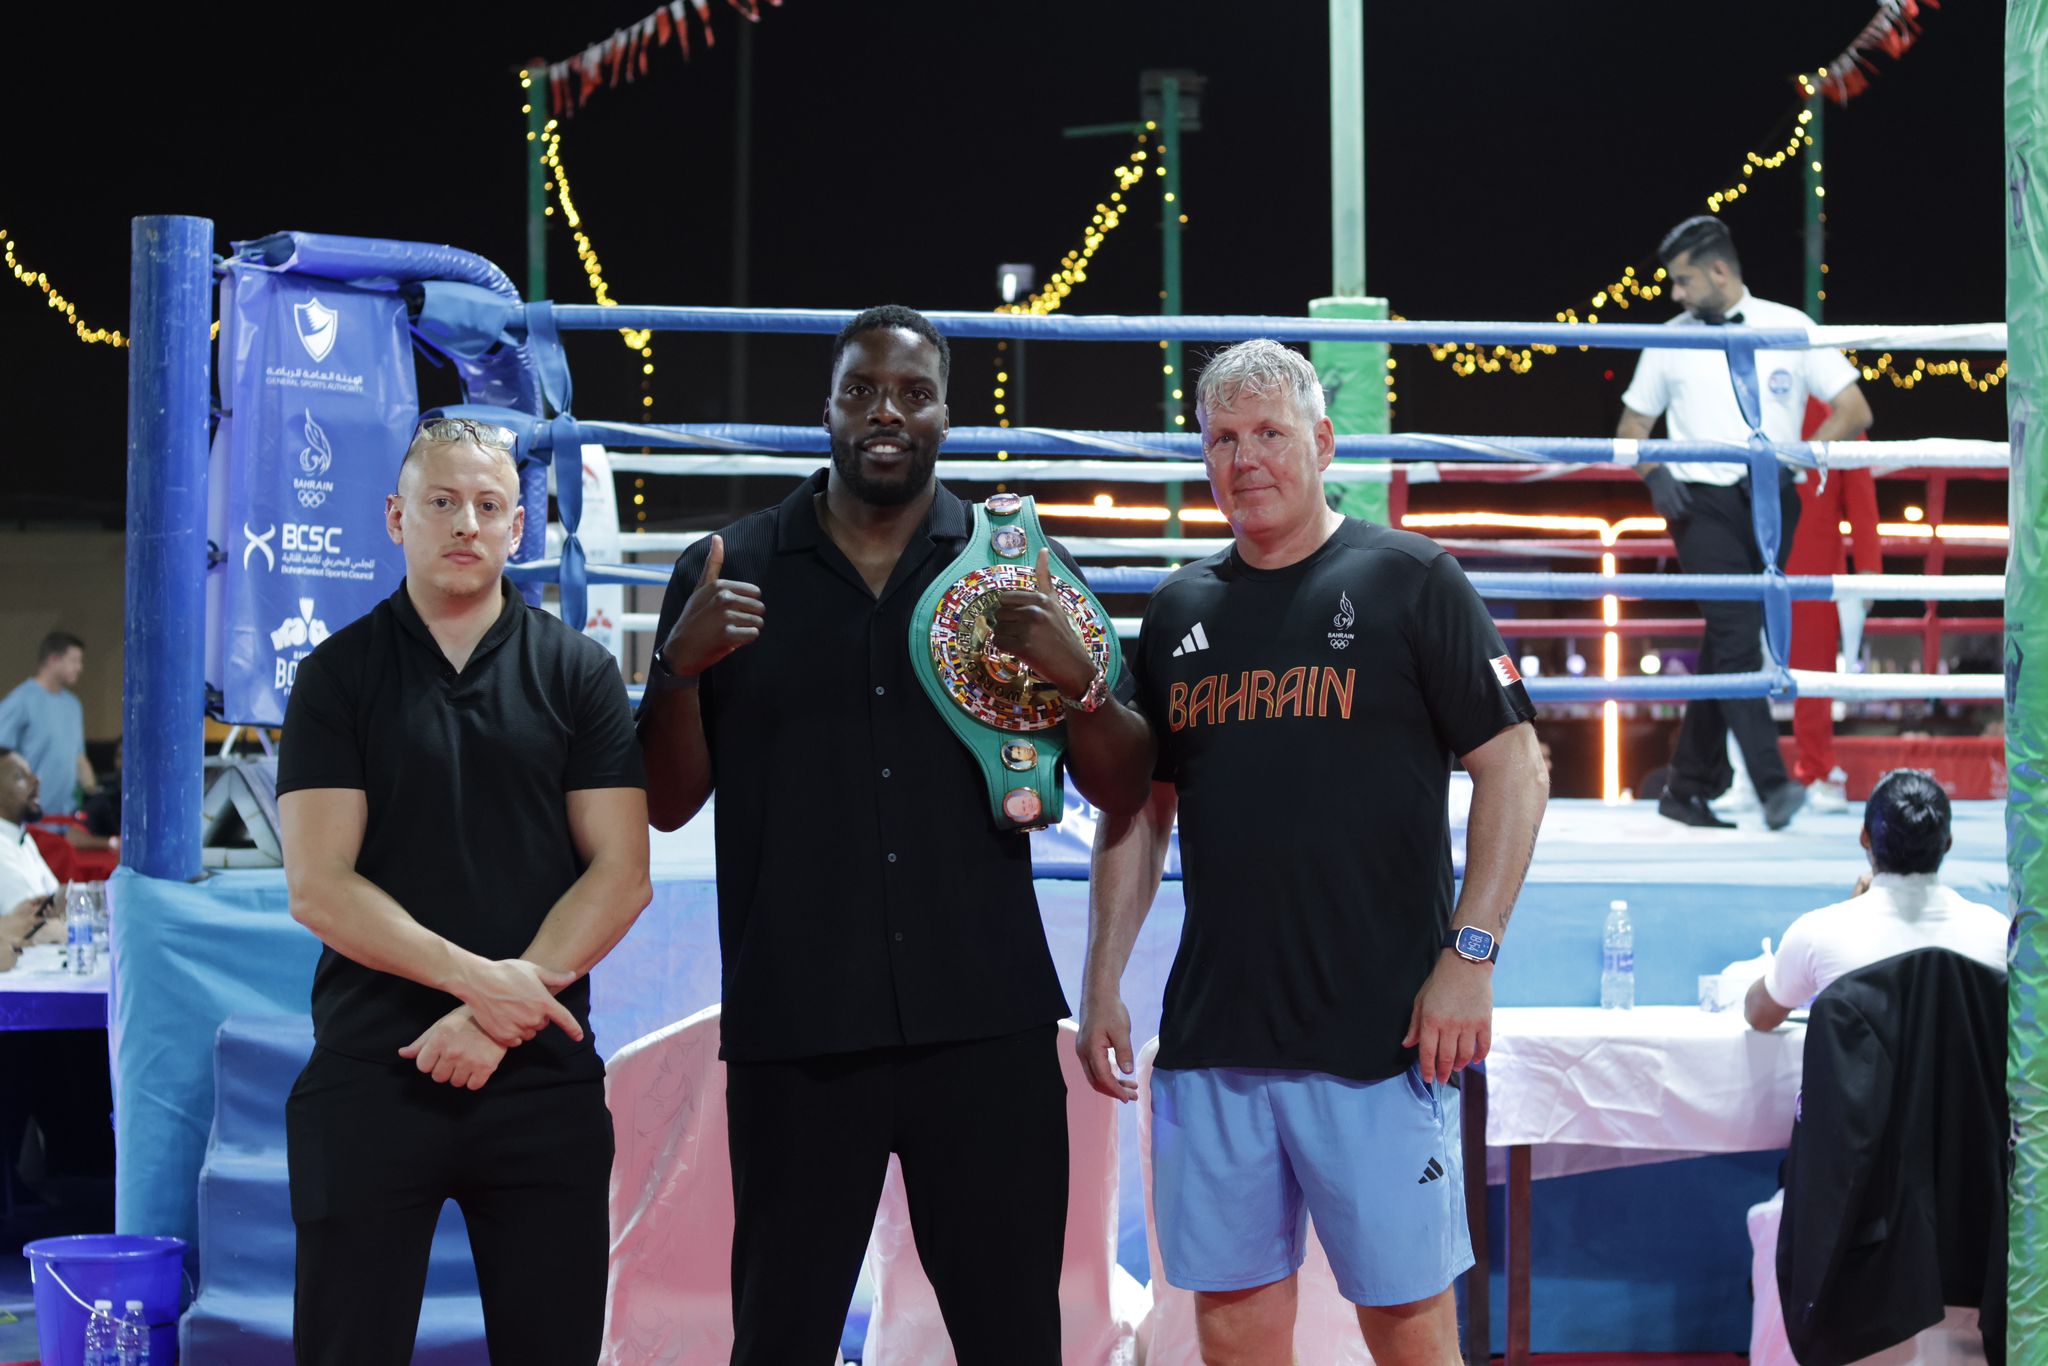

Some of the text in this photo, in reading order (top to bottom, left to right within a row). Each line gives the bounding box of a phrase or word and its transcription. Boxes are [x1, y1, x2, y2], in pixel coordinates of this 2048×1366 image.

[265, 377, 364, 393] GENERAL SPORTS AUTHORITY
[293, 477, 334, 492] BAHRAIN
[281, 523, 343, 554] BCSC
[324, 568, 348, 579] Sports
[348, 570, 374, 581] Council
[1327, 632, 1355, 640] BAHRAIN
[1168, 666, 1356, 733] BAHRAIN
